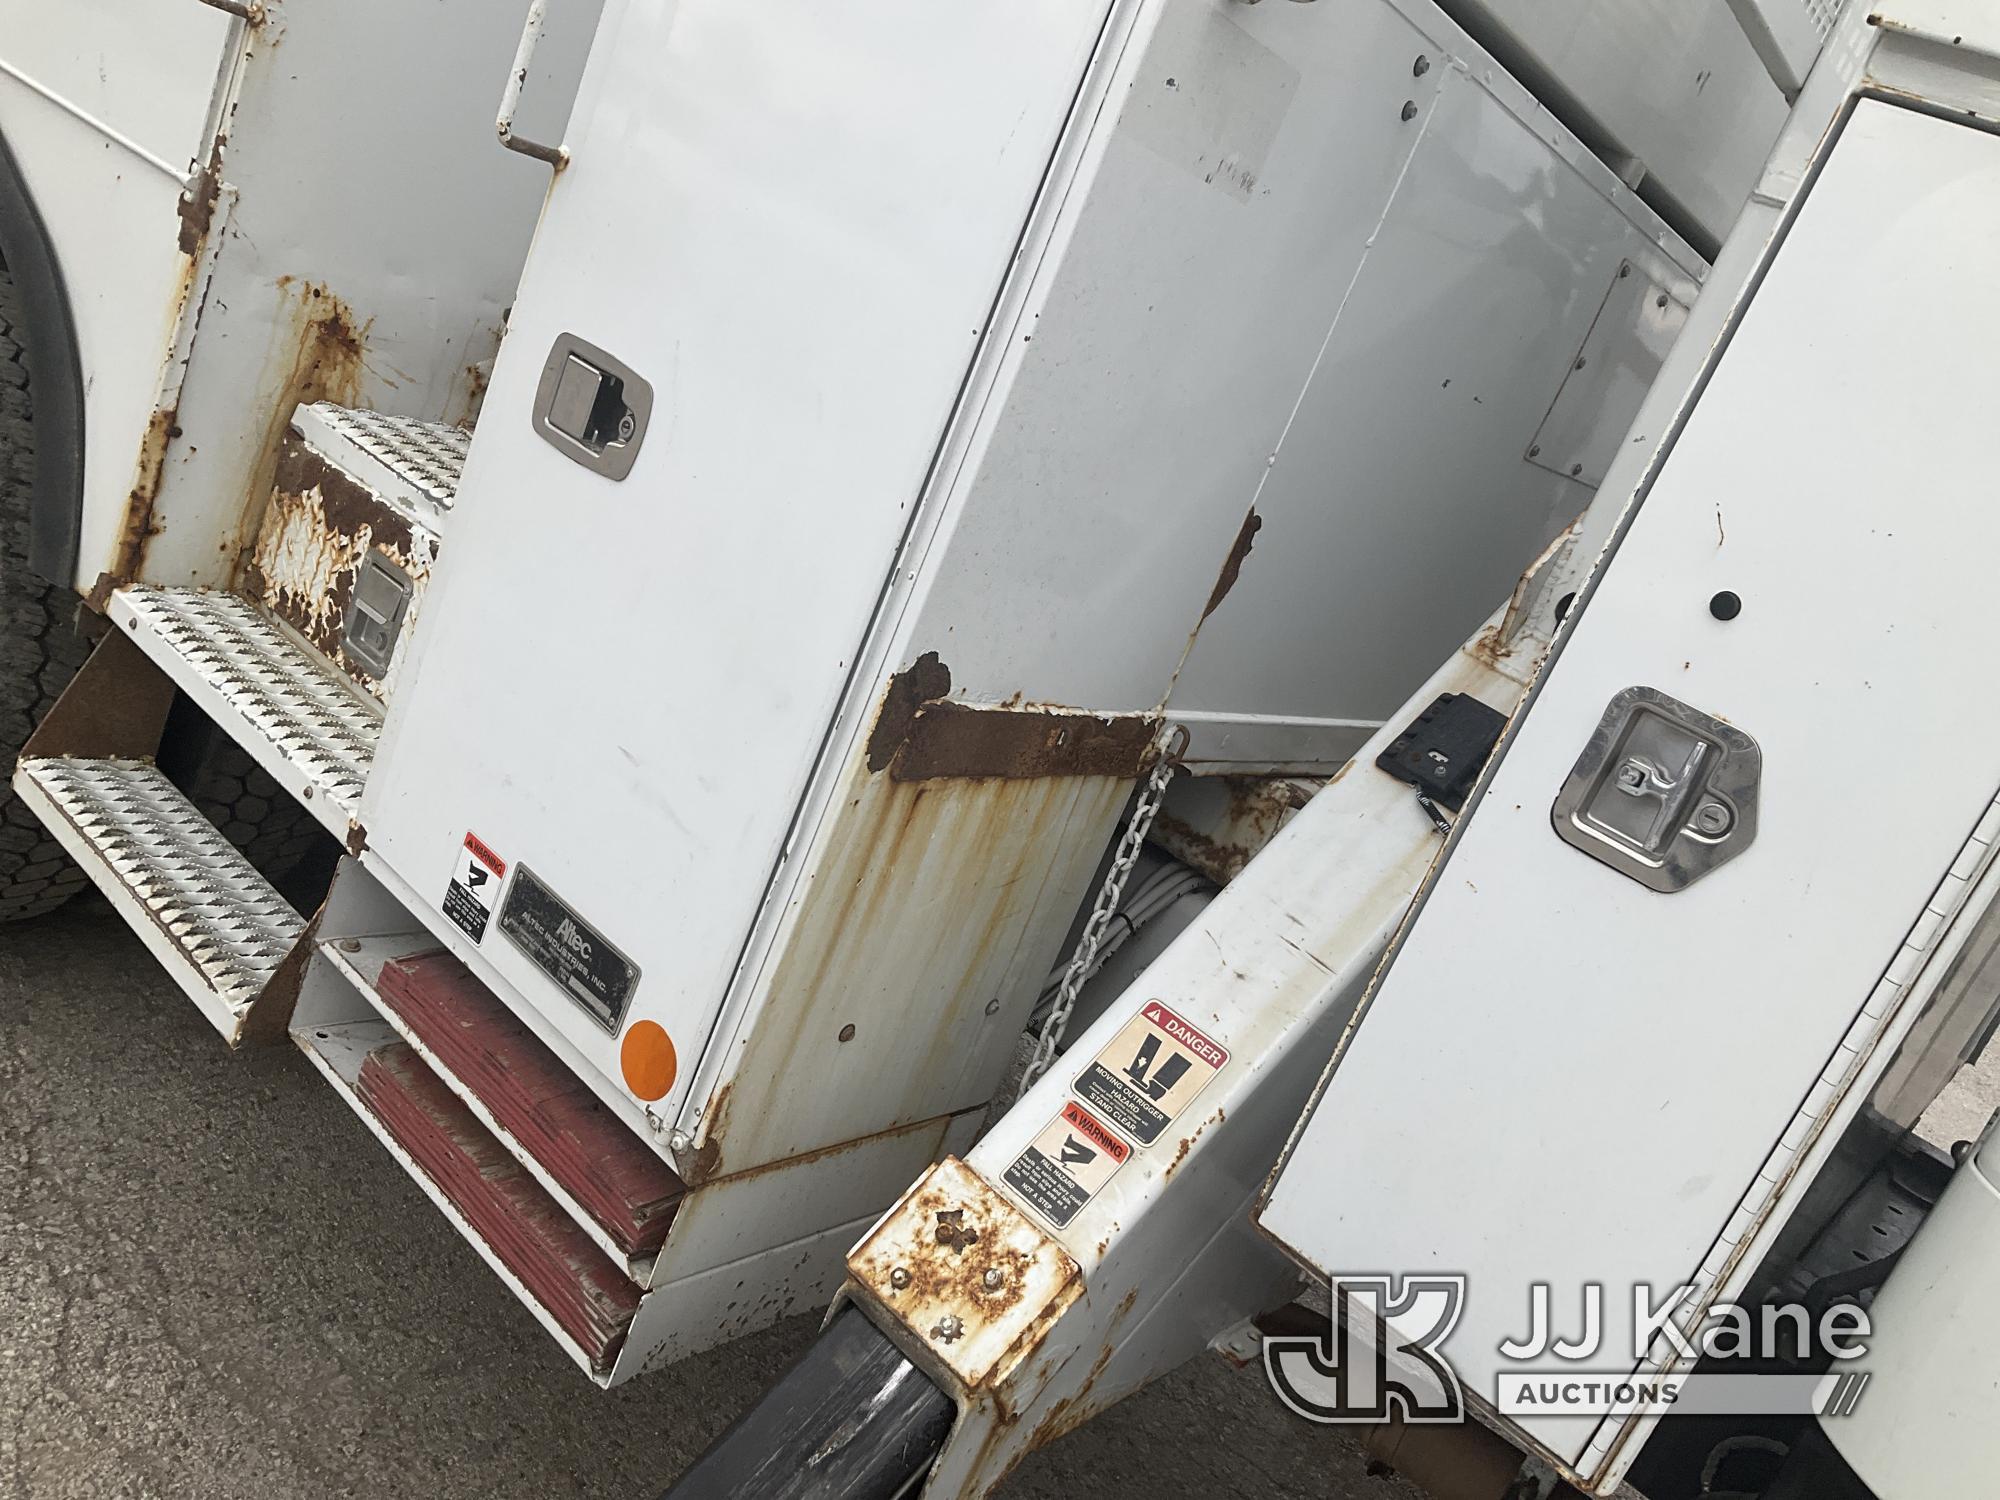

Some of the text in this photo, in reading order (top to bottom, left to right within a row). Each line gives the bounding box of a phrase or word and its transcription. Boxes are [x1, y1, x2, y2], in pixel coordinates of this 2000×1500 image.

[473, 842, 502, 874] WARNING
[521, 909, 544, 935] ALTEC
[543, 930, 591, 980] INDUSTRIES,
[590, 973, 608, 994] INC.
[1164, 1018, 1223, 1064] DANGER
[1088, 1091, 1136, 1131] STAND CLEAR
[1094, 1066, 1165, 1121] MOVING OUTRIGGER
[1110, 1088, 1140, 1113] HAZARD
[1076, 1115, 1125, 1157] WARNING
[1009, 1167, 1021, 1177] step.
[1018, 1158, 1031, 1170] result
[1030, 1169, 1042, 1179] from
[1040, 1178, 1052, 1189] slips
[1051, 1187, 1061, 1196] and
[1020, 1168, 1029, 1176] not
[1028, 1175, 1038, 1184] use
[1037, 1182, 1047, 1191] this
[1046, 1190, 1057, 1200] area
[1021, 1153, 1036, 1166] Death
[1040, 1169, 1057, 1184] serious
[1055, 1183, 1070, 1195] injury
[1068, 1193, 1082, 1206] could
[1039, 1158, 1075, 1189] FALL HAZARD
[1021, 1182, 1033, 1194] NOT
[1037, 1196, 1052, 1210] STEP
